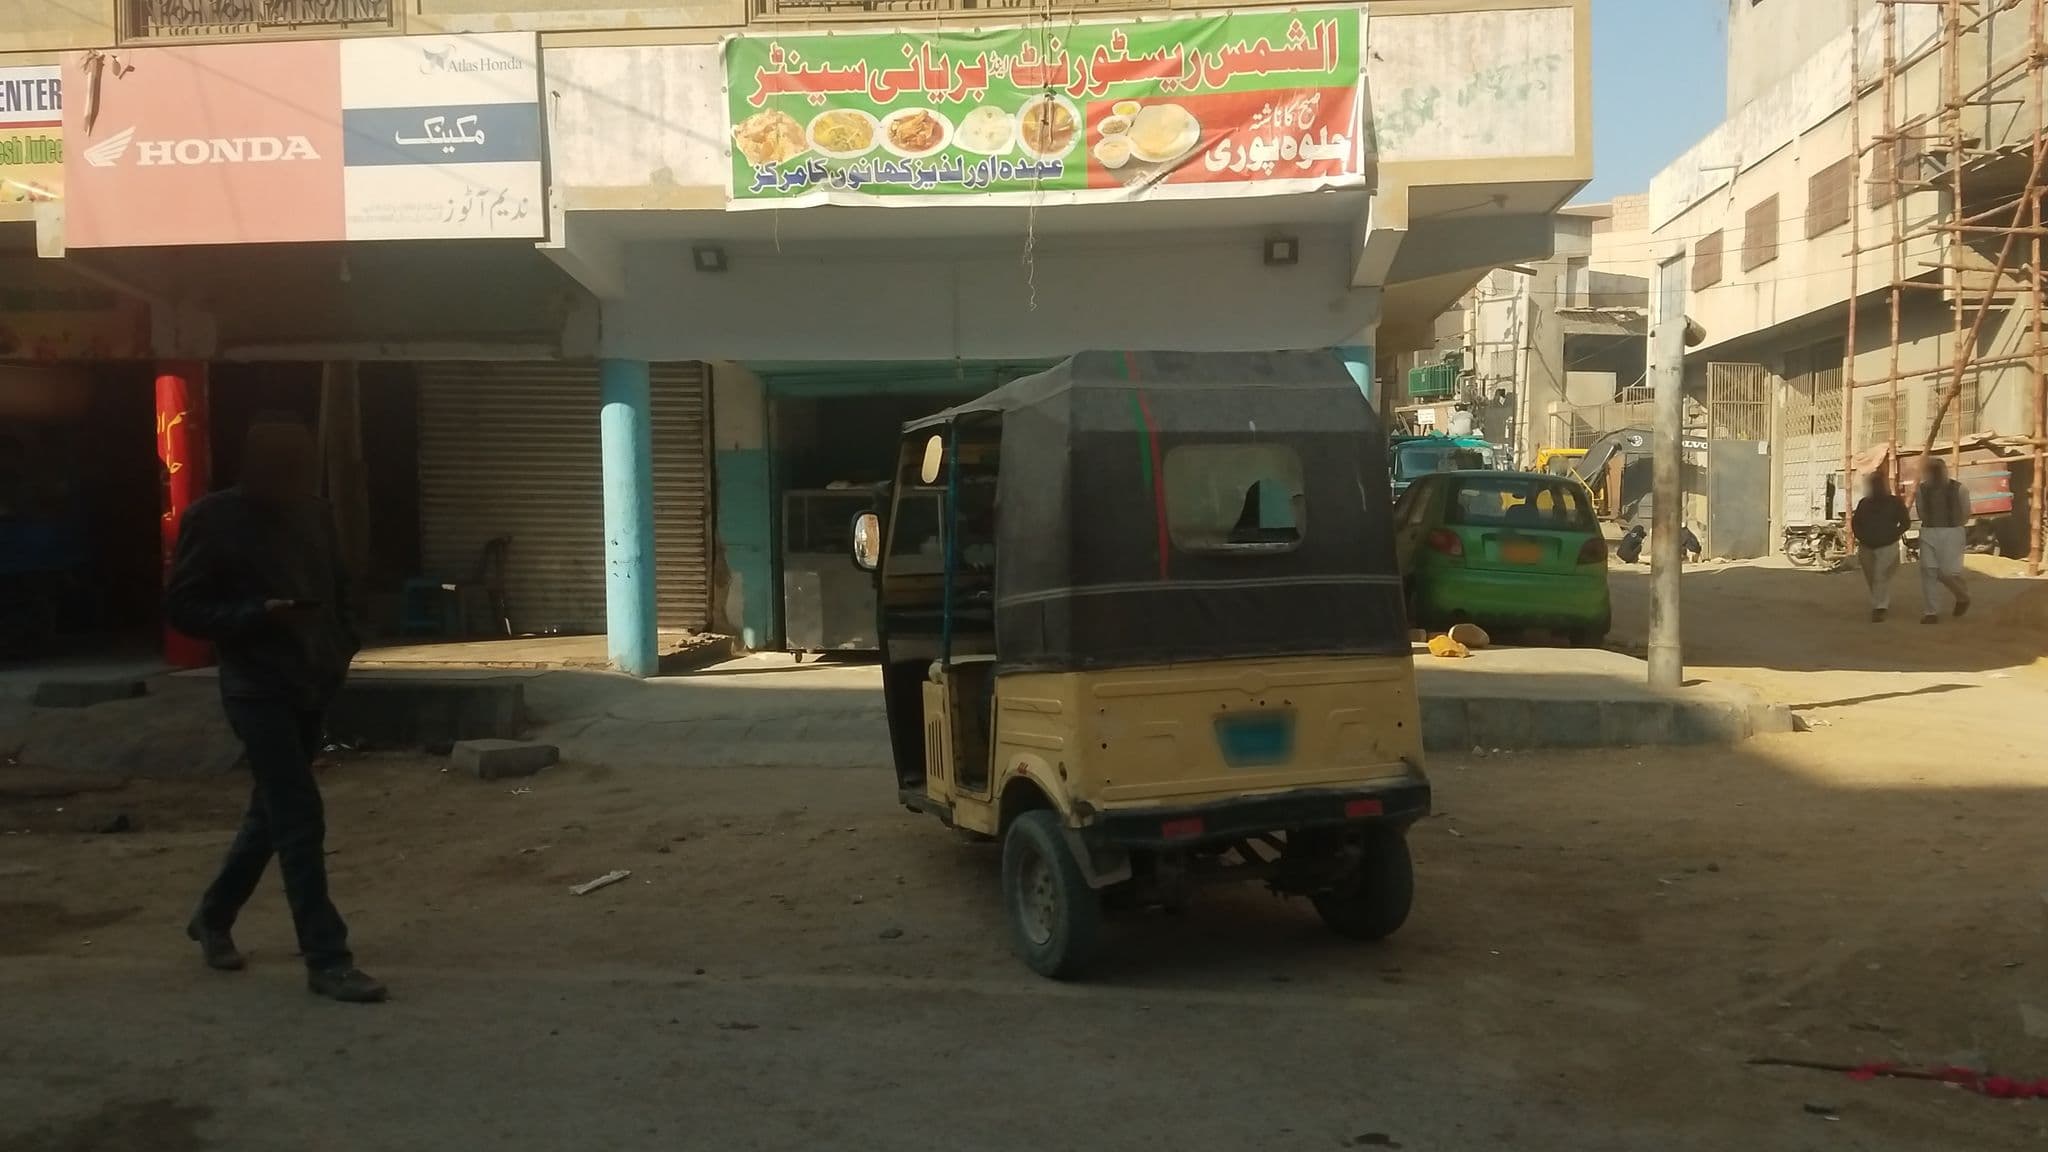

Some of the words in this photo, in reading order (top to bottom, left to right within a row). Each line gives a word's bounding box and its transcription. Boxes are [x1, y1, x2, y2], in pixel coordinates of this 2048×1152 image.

[448, 58, 479, 73] Atlas
[480, 56, 523, 72] Honda
[868, 40, 989, 104] بریانی
[1009, 28, 1204, 98] ریسٹورنٹ
[1203, 18, 1339, 88] الشمس
[747, 41, 869, 107] سینٹر
[136, 136, 321, 166] HONDA
[395, 114, 486, 153] مکینک
[1280, 125, 1351, 171] حلوہ
[806, 157, 829, 184] کا
[910, 154, 964, 190] لذیز
[962, 154, 998, 190] اور
[998, 157, 1064, 181] عمدہ
[1204, 135, 1281, 177] پوری
[748, 160, 808, 193] مرکز
[491, 187, 528, 232] ندیم
